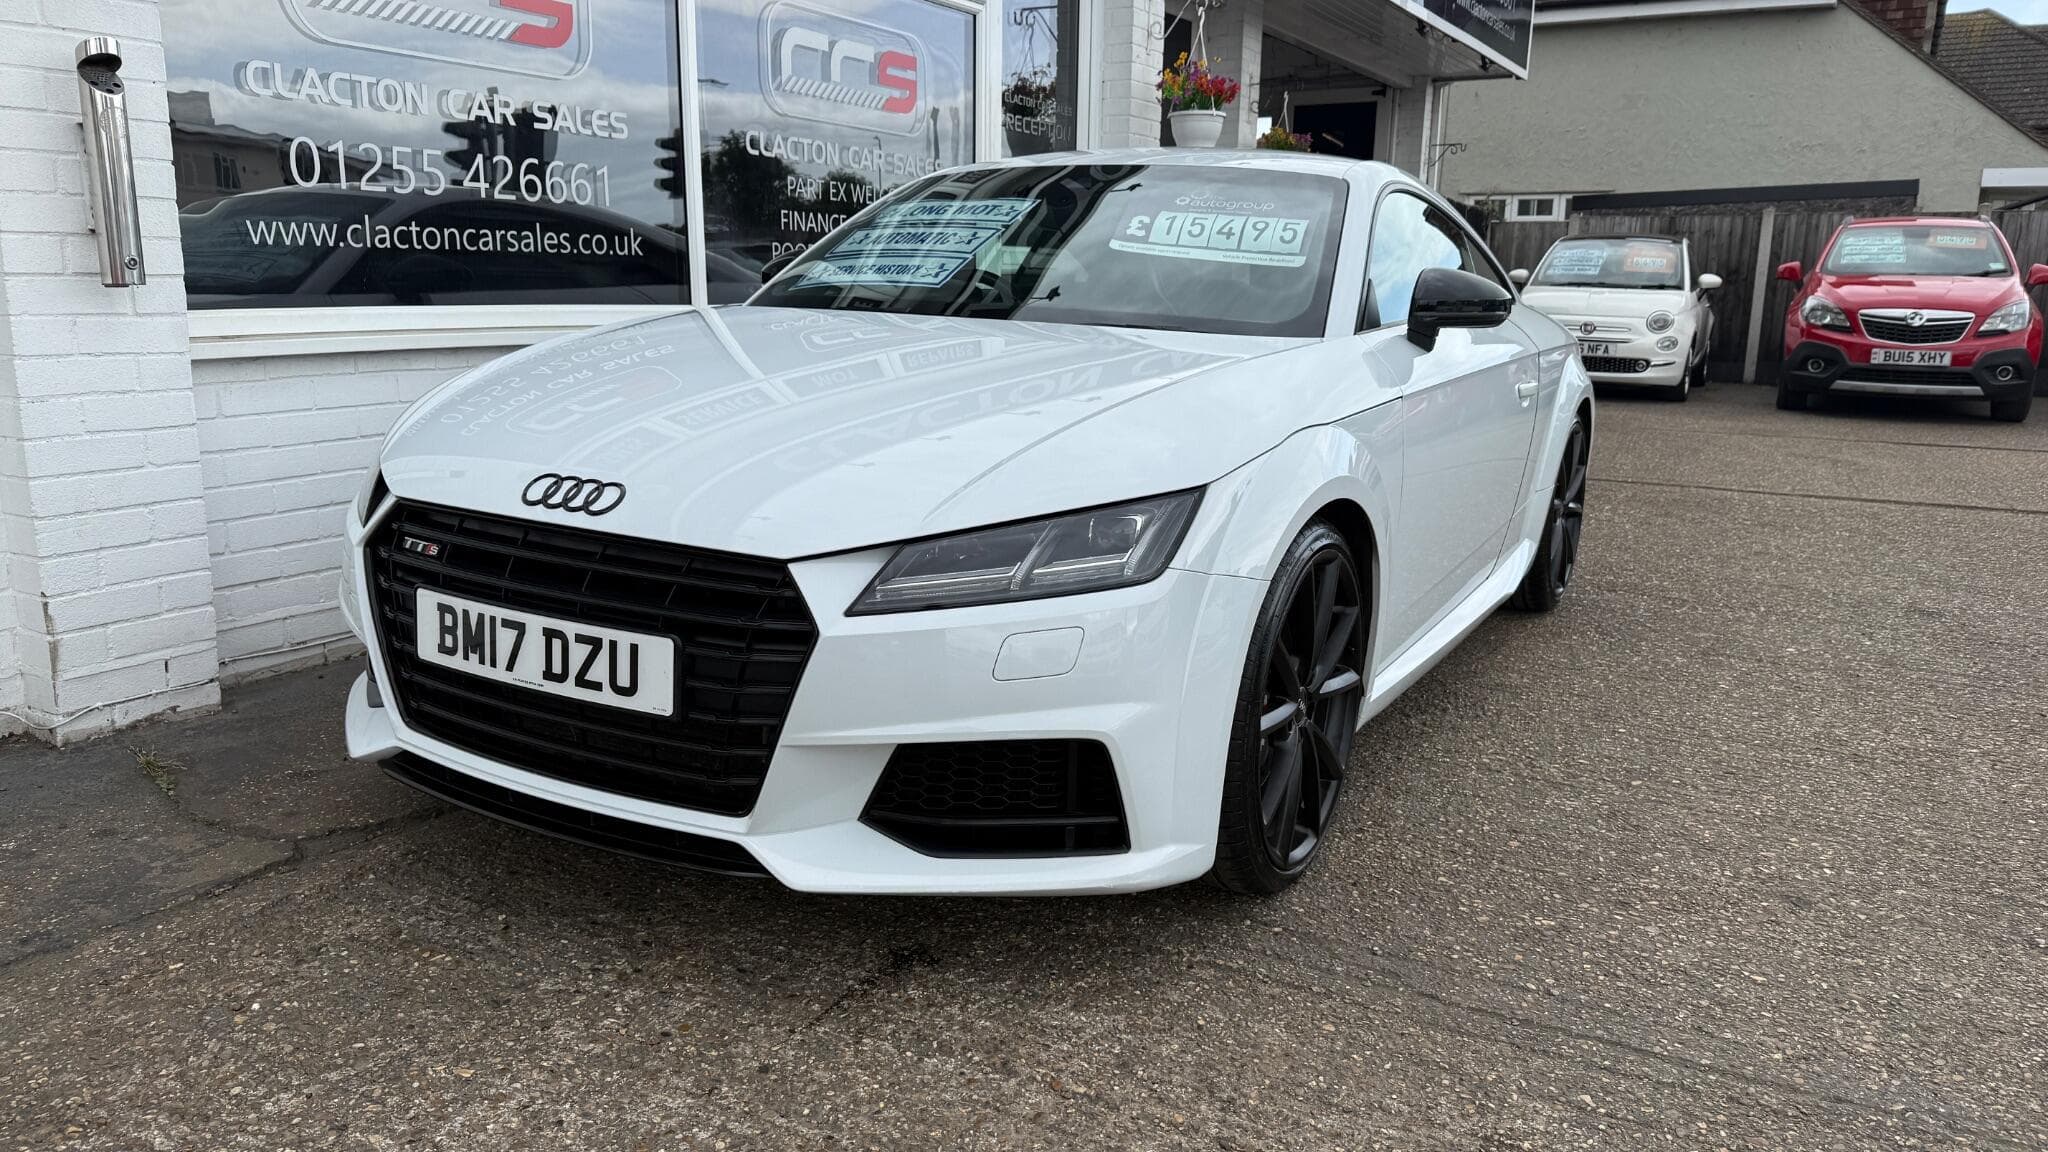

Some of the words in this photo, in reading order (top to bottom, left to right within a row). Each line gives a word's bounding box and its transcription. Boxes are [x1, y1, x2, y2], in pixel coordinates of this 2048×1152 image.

[780, 26, 919, 114] CCS
[245, 59, 430, 115] CLACTON
[447, 88, 518, 127] CAR
[532, 100, 629, 140] SALES
[745, 130, 840, 166] CLACTON
[848, 145, 885, 173] CAR
[289, 136, 446, 196] 01255
[462, 153, 610, 208] 426661
[787, 175, 825, 200] PART
[829, 181, 848, 202] EX
[952, 204, 1003, 216] MOT
[1189, 199, 1275, 212] autogroup
[245, 214, 644, 257] www.clactoncarsales.co.uk
[869, 231, 958, 245] AUTOMATIC
[873, 263, 924, 276] HISTORY
[1587, 343, 1609, 355] NFA
[1882, 350, 1915, 363] BU15
[1918, 351, 1947, 364] XHY
[404, 536, 439, 556] TTS
[436, 601, 527, 674] BM17
[541, 626, 639, 698] DZU
